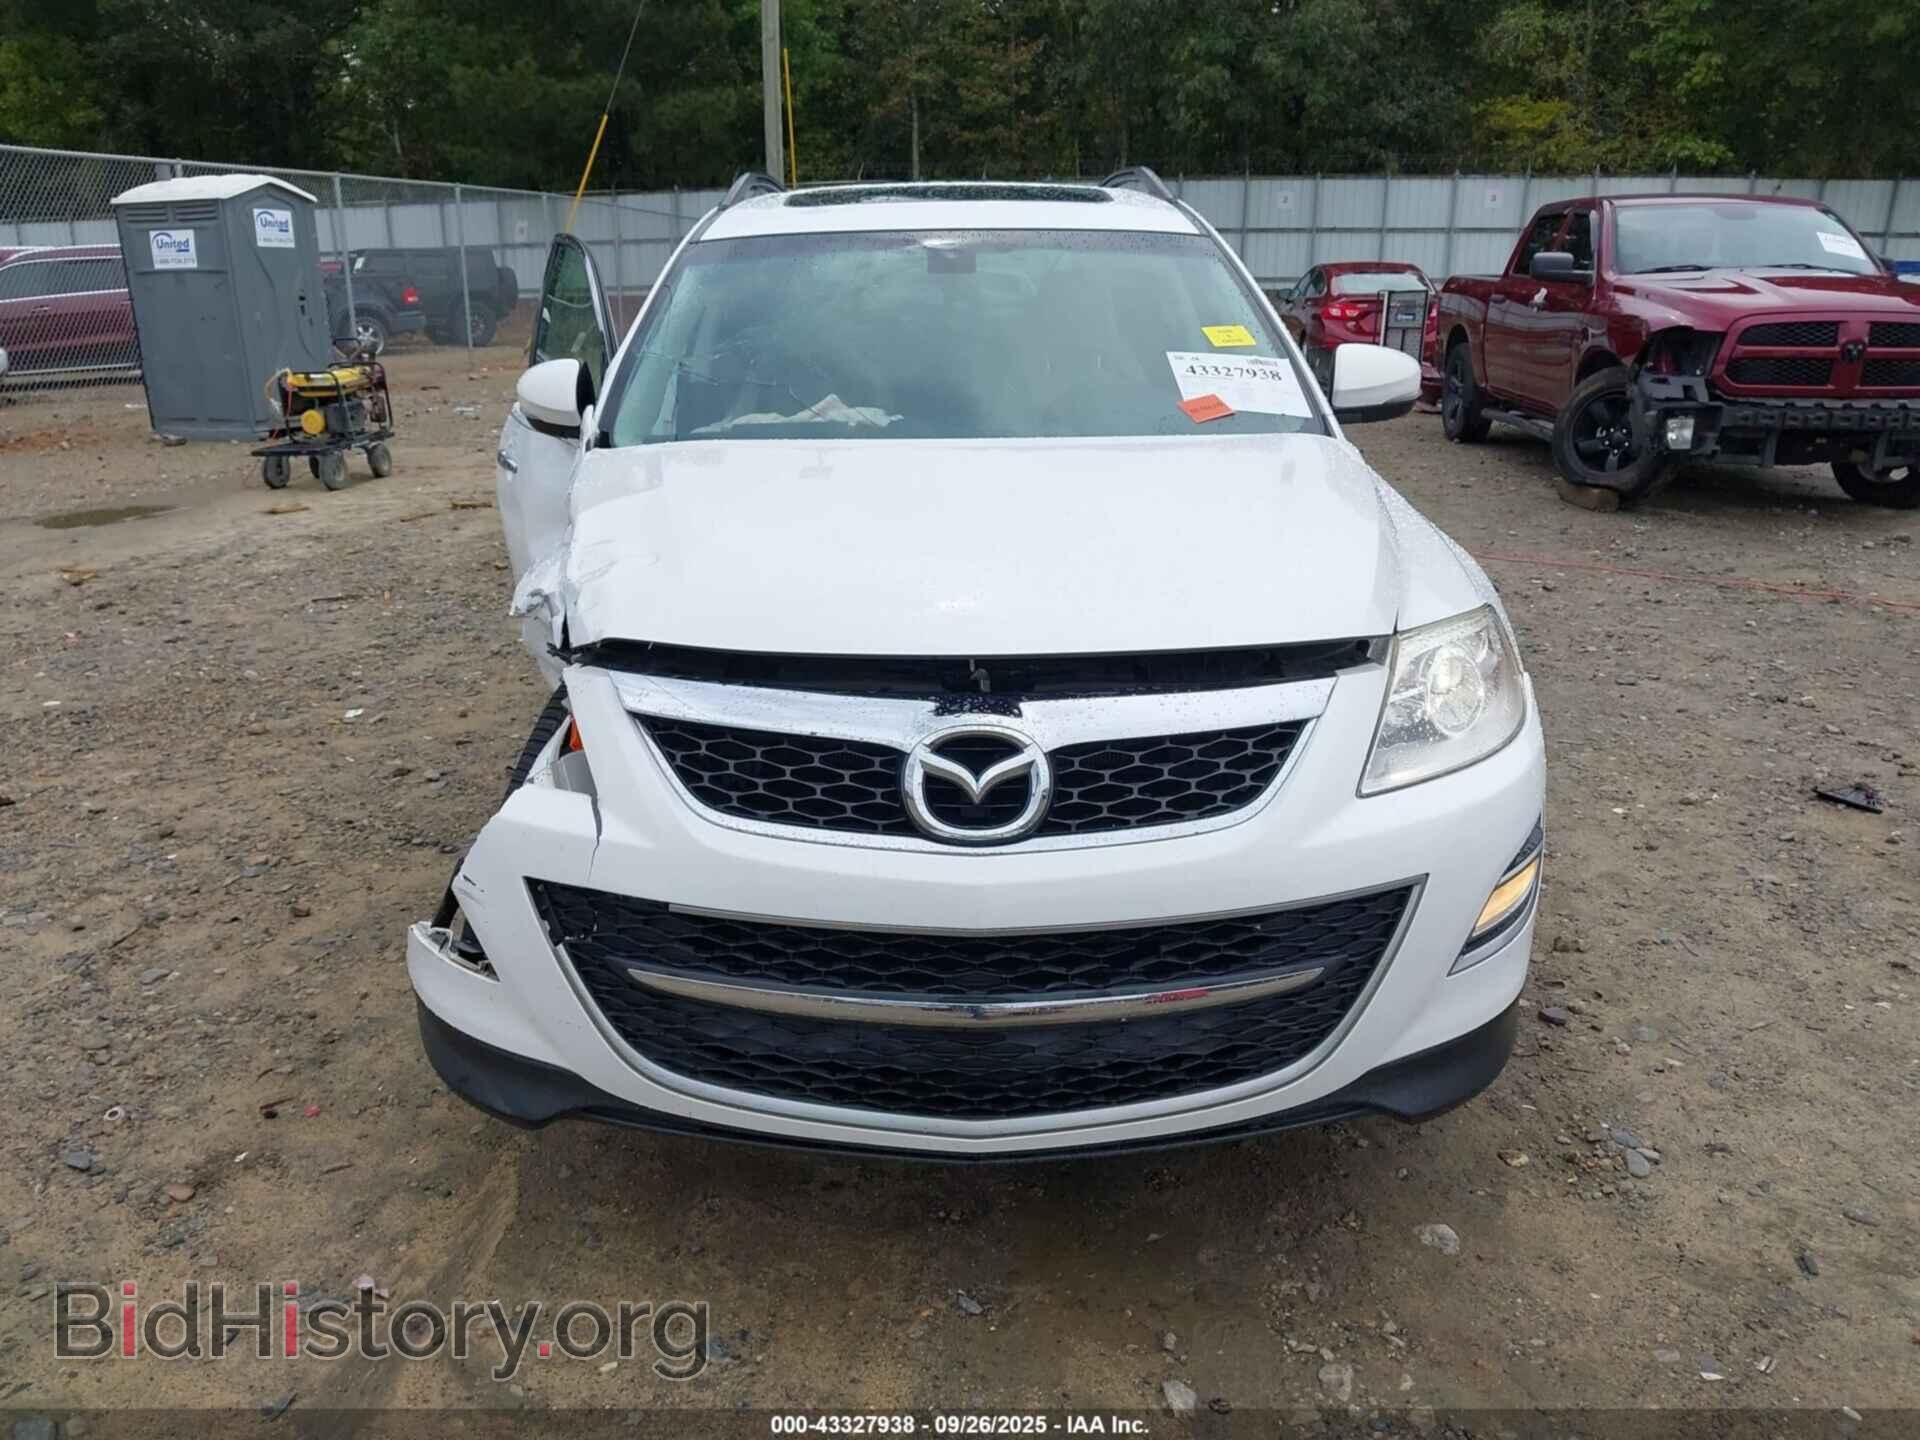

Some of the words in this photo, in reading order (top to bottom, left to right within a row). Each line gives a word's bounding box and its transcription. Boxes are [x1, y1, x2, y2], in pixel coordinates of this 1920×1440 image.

[260, 216, 289, 228] United
[156, 238, 189, 249] United
[1185, 364, 1282, 381] 43327938
